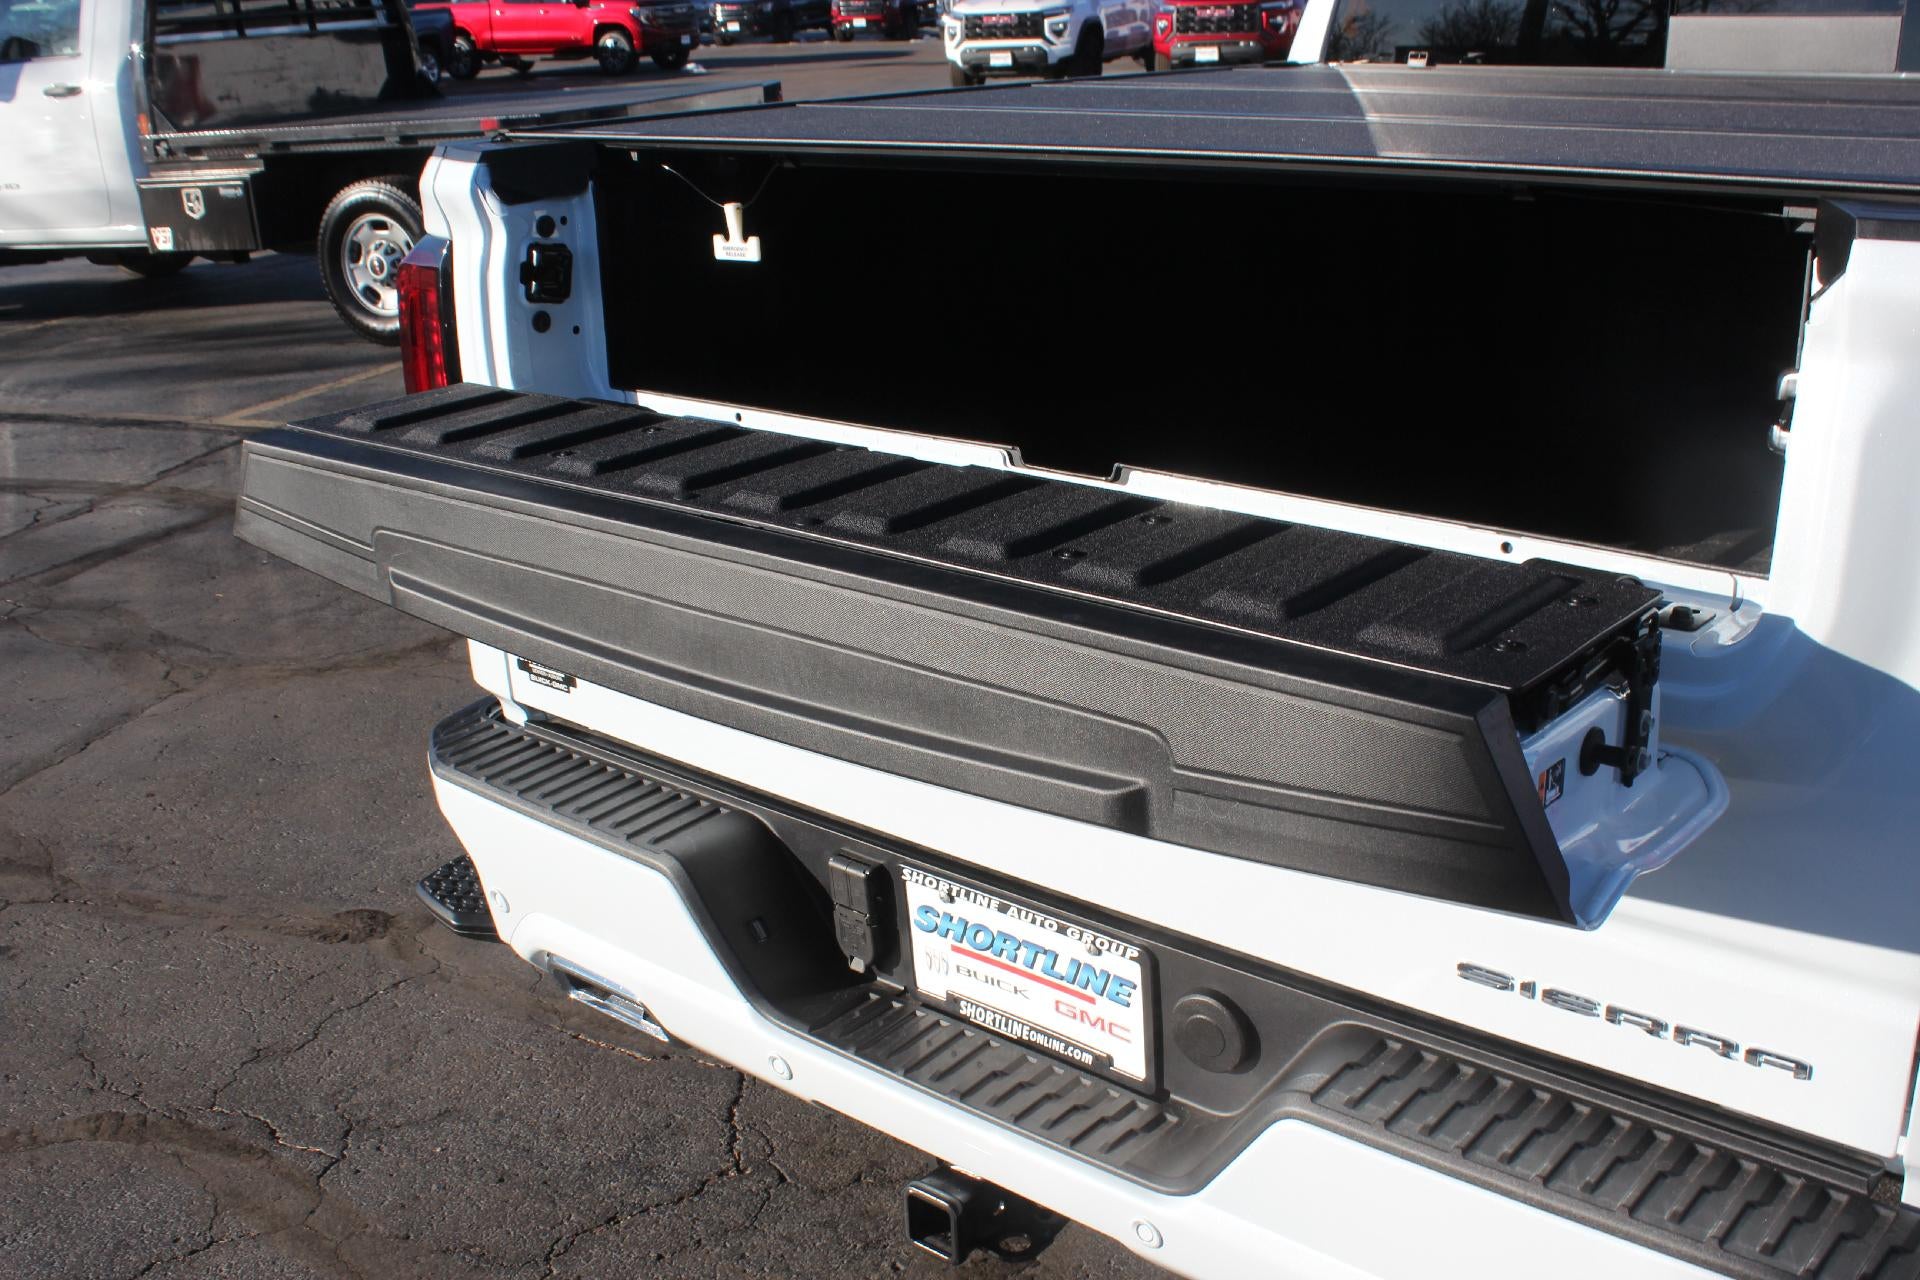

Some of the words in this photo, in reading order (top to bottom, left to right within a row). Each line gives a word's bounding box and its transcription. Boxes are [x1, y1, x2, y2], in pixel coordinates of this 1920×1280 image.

[901, 868, 1000, 912] SHORTLINE
[1006, 906, 1059, 933] AUTO
[1066, 926, 1140, 961] GROUP
[913, 904, 1138, 1008] SHORTLINE
[956, 964, 1031, 1001] BUICK
[1054, 999, 1132, 1044] GMC
[1456, 961, 1814, 1082] SIERRA
